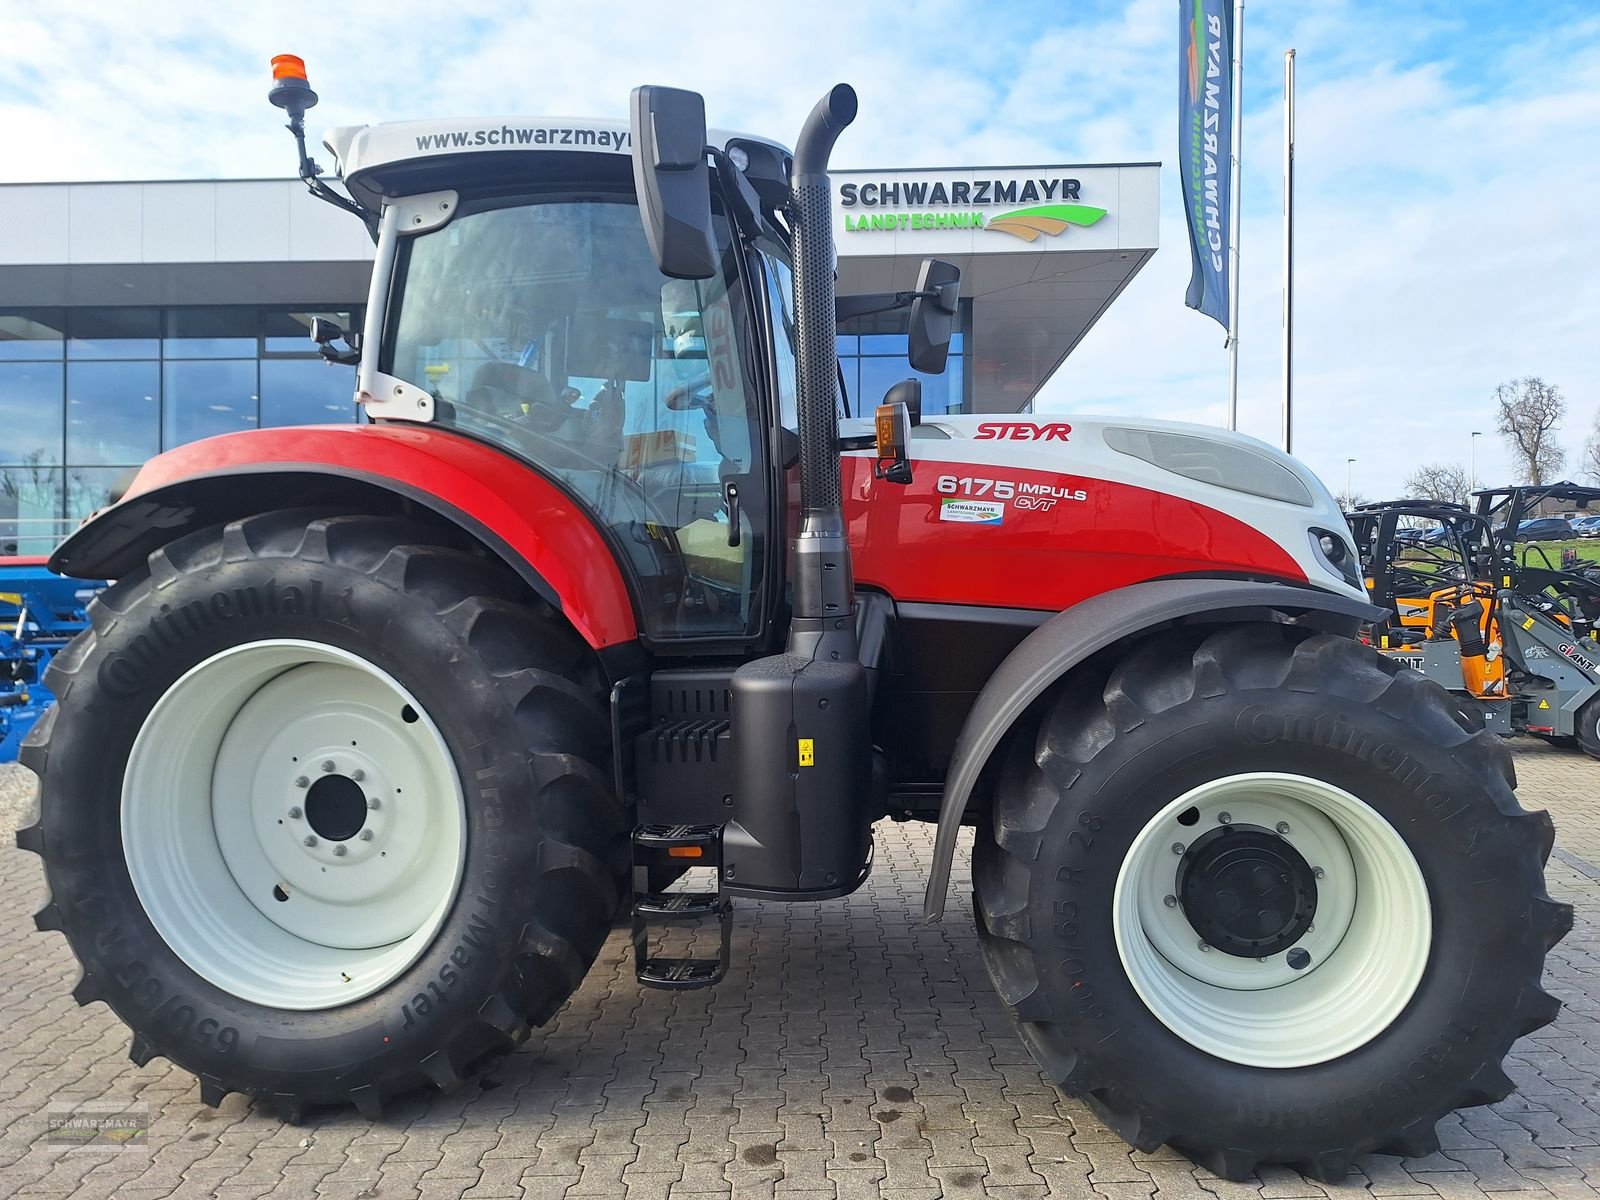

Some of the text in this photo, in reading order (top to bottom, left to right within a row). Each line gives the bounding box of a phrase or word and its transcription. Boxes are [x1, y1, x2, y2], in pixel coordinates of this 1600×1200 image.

[840, 178, 1081, 207] SCHWARZMAYR
[844, 211, 984, 232] LANDTECHNIK
[973, 422, 1072, 441] STEYR
[937, 475, 1087, 501] 6175 IMPULS
[946, 503, 996, 513] SCHWARZMAYR
[1014, 496, 1057, 512] CVT
[97, 577, 323, 698] Continental
